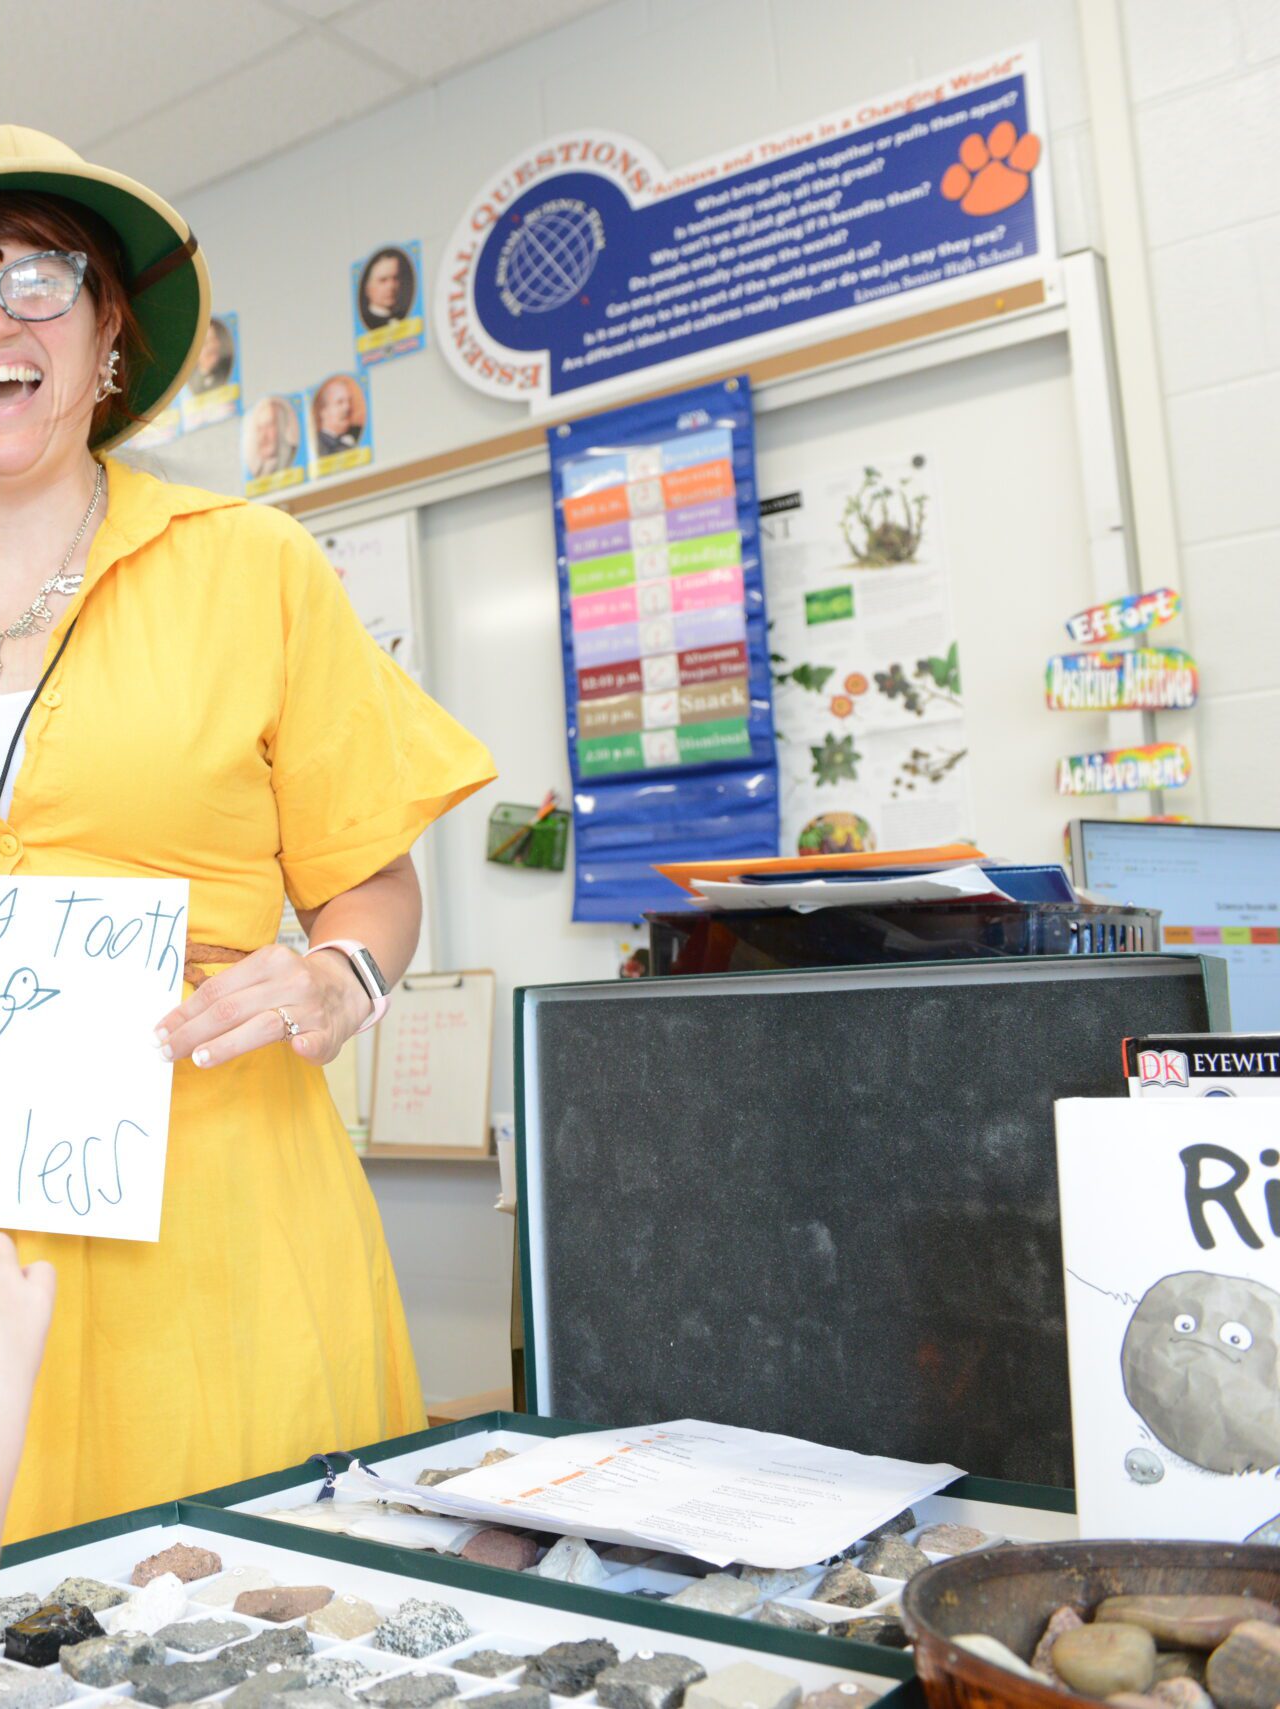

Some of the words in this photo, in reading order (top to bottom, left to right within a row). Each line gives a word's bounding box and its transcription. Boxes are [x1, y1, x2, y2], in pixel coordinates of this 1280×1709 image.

[694, 190, 730, 213] What
[730, 178, 771, 201] brings
[770, 161, 817, 189] people
[816, 141, 875, 171] together
[875, 135, 893, 151] or
[893, 123, 930, 148] pulls
[929, 110, 969, 132] them
[969, 90, 1019, 120] apart?
[723, 151, 754, 172] and
[759, 133, 814, 157] Thrive
[819, 124, 836, 137] in
[857, 85, 945, 123] Changing
[471, 139, 650, 231] QUESTIONS
[650, 247, 680, 266] Why
[711, 230, 731, 246] we
[731, 221, 748, 239] all
[748, 214, 774, 237] just
[774, 206, 797, 227] get
[798, 190, 843, 217] along?
[673, 226, 688, 241] Is
[687, 203, 755, 236] technology
[755, 190, 792, 212] really
[792, 182, 811, 200] all
[811, 173, 840, 194] that
[840, 157, 885, 187] great?
[605, 302, 631, 318] Can
[630, 294, 654, 311] one
[653, 280, 696, 306] person
[696, 268, 731, 288] really
[732, 253, 778, 278] change
[777, 246, 802, 263] the
[801, 228, 849, 256] world?
[628, 276, 648, 292] Do
[648, 262, 689, 288] people
[689, 253, 718, 271] only
[719, 246, 737, 262] do
[737, 224, 804, 256] something
[804, 217, 817, 234] if
[816, 215, 830, 230] it
[829, 199, 886, 226] benefits
[886, 181, 932, 208] them?
[900, 268, 943, 289] Senior
[943, 256, 977, 278] High
[976, 241, 1023, 268] School
[448, 250, 543, 390] ESSENTIAL
[561, 356, 585, 373] Are
[584, 338, 635, 365] different
[634, 330, 668, 349] ideas
[668, 319, 693, 340] and
[692, 306, 743, 331] cultures
[742, 294, 780, 316] really
[838, 271, 859, 287] do
[859, 264, 881, 281] we
[880, 254, 910, 278] just
[910, 248, 937, 266] say
[936, 237, 971, 257] they
[972, 224, 1007, 247] are?
[583, 332, 596, 346] Is
[607, 322, 628, 339] our
[628, 313, 657, 332] duty
[656, 308, 672, 323] to
[671, 303, 690, 318] be
[699, 289, 728, 312] part
[727, 283, 744, 300] of
[743, 278, 767, 295] the
[767, 263, 807, 288] world
[806, 248, 856, 276] around
[856, 240, 882, 261] us?
[1070, 589, 1172, 642] Effort
[680, 687, 746, 714] Snack
[1052, 656, 1118, 708] Positive
[1122, 651, 1196, 708] Attitude
[1059, 747, 1186, 795] Achievement
[55, 890, 185, 992] Tooth
[1140, 1052, 1185, 1082] DK
[1193, 1052, 1280, 1073] EYEWIT
[1179, 1143, 1280, 1250] Ri
